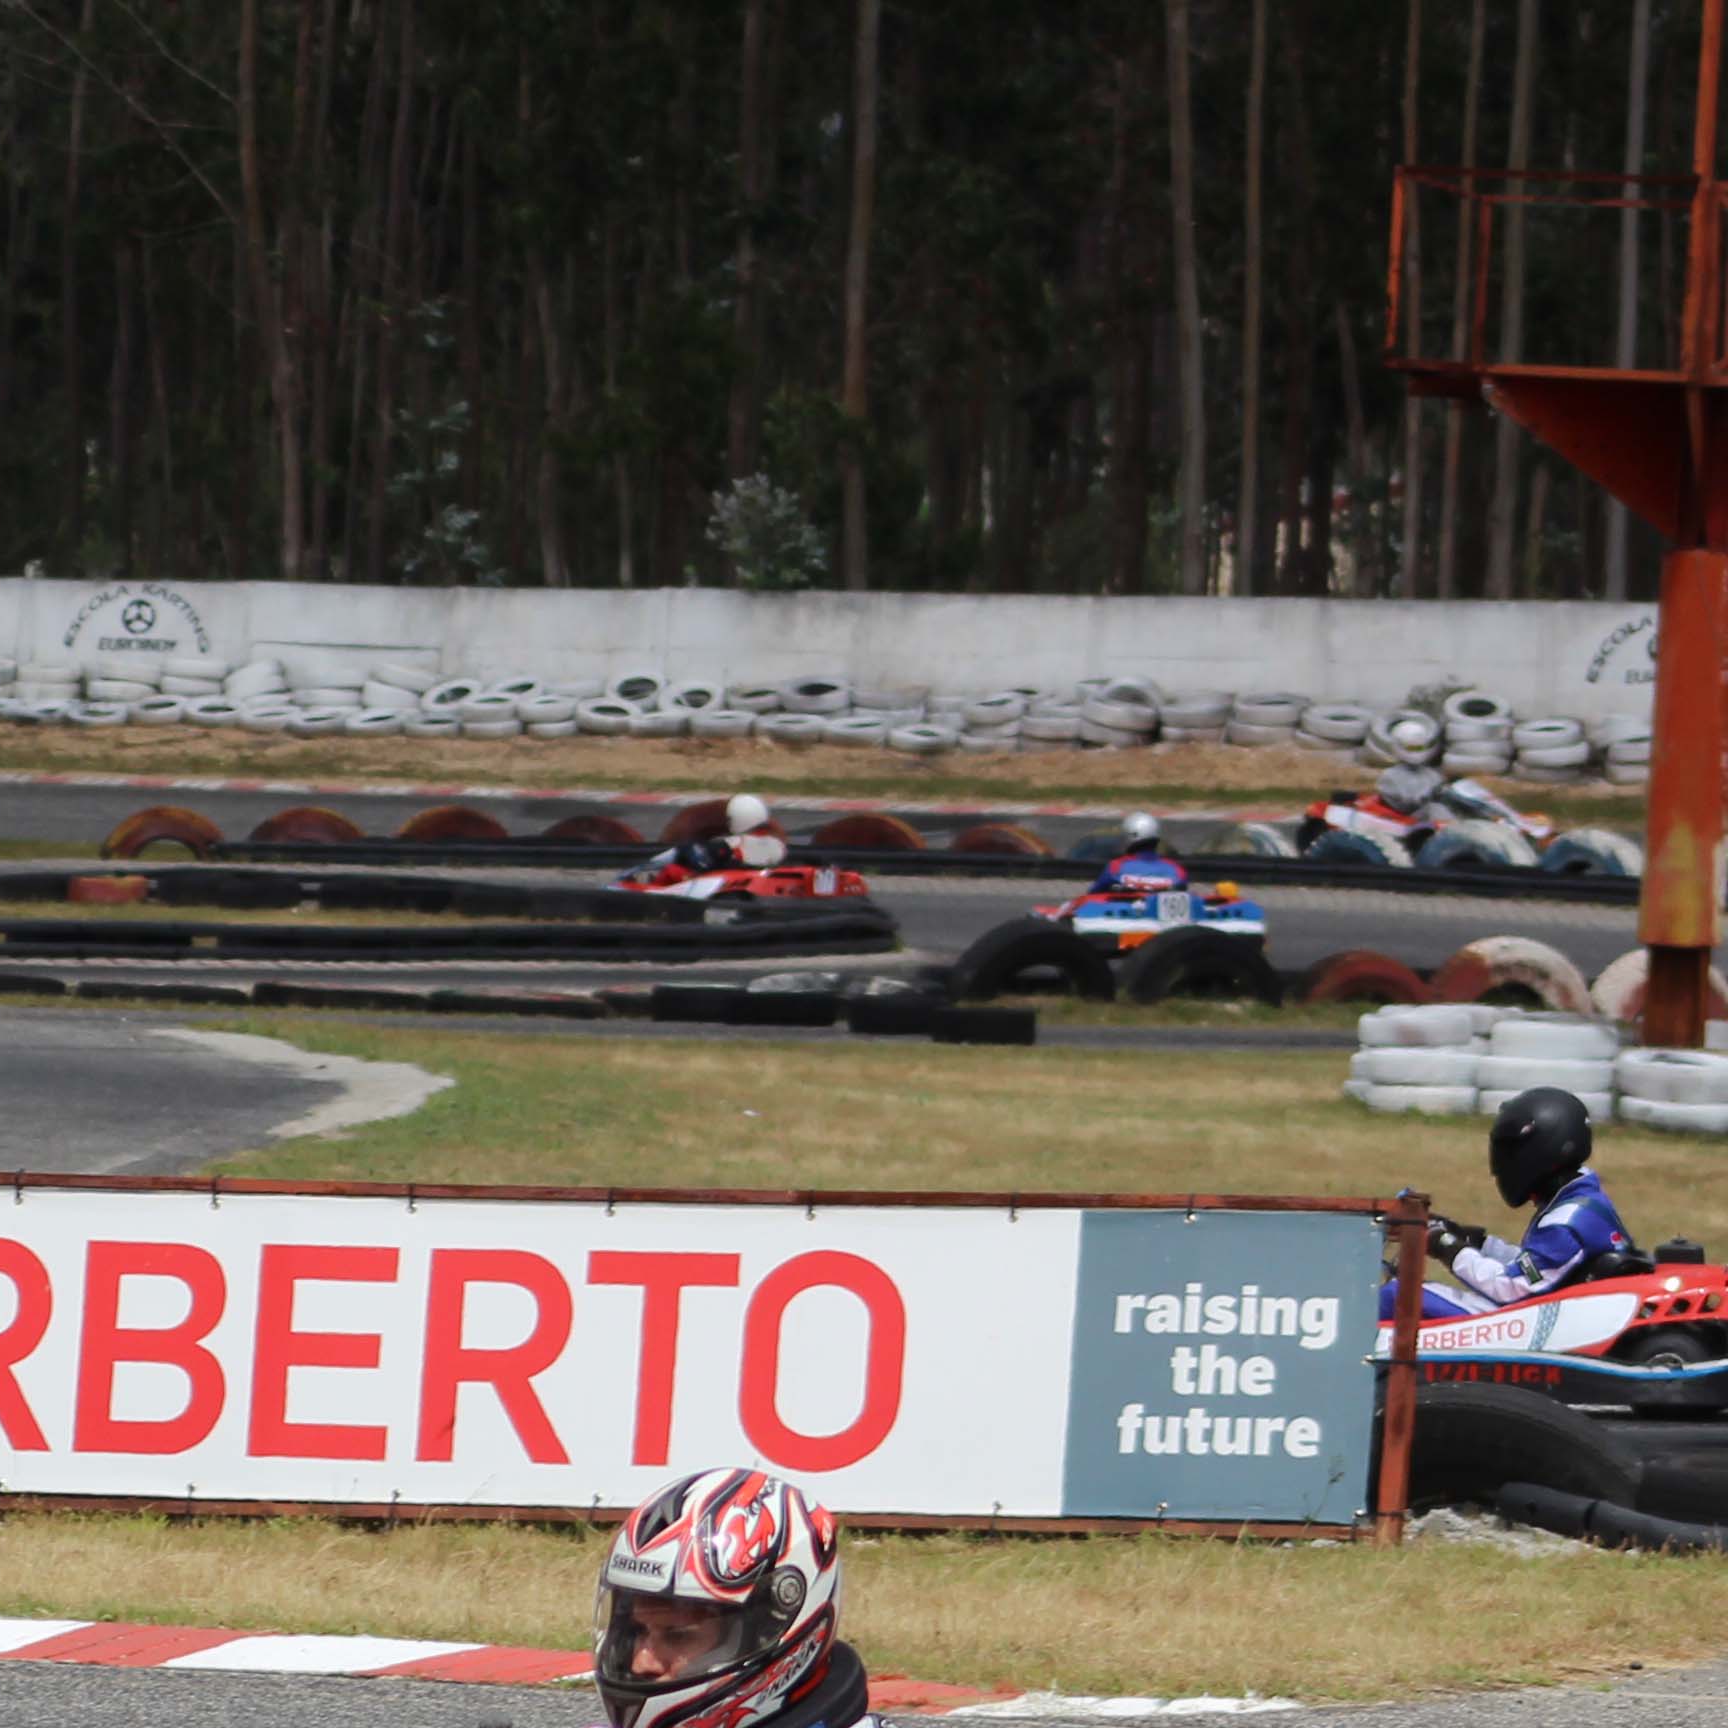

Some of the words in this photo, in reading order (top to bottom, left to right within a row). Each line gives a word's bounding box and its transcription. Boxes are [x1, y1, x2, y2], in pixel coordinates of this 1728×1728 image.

[1115, 1283, 1340, 1349] raising
[1388, 1319, 1526, 1350] RBERTO
[1171, 1345, 1275, 1397] the
[1117, 1404, 1320, 1458] future
[611, 1552, 664, 1577] SHARK
